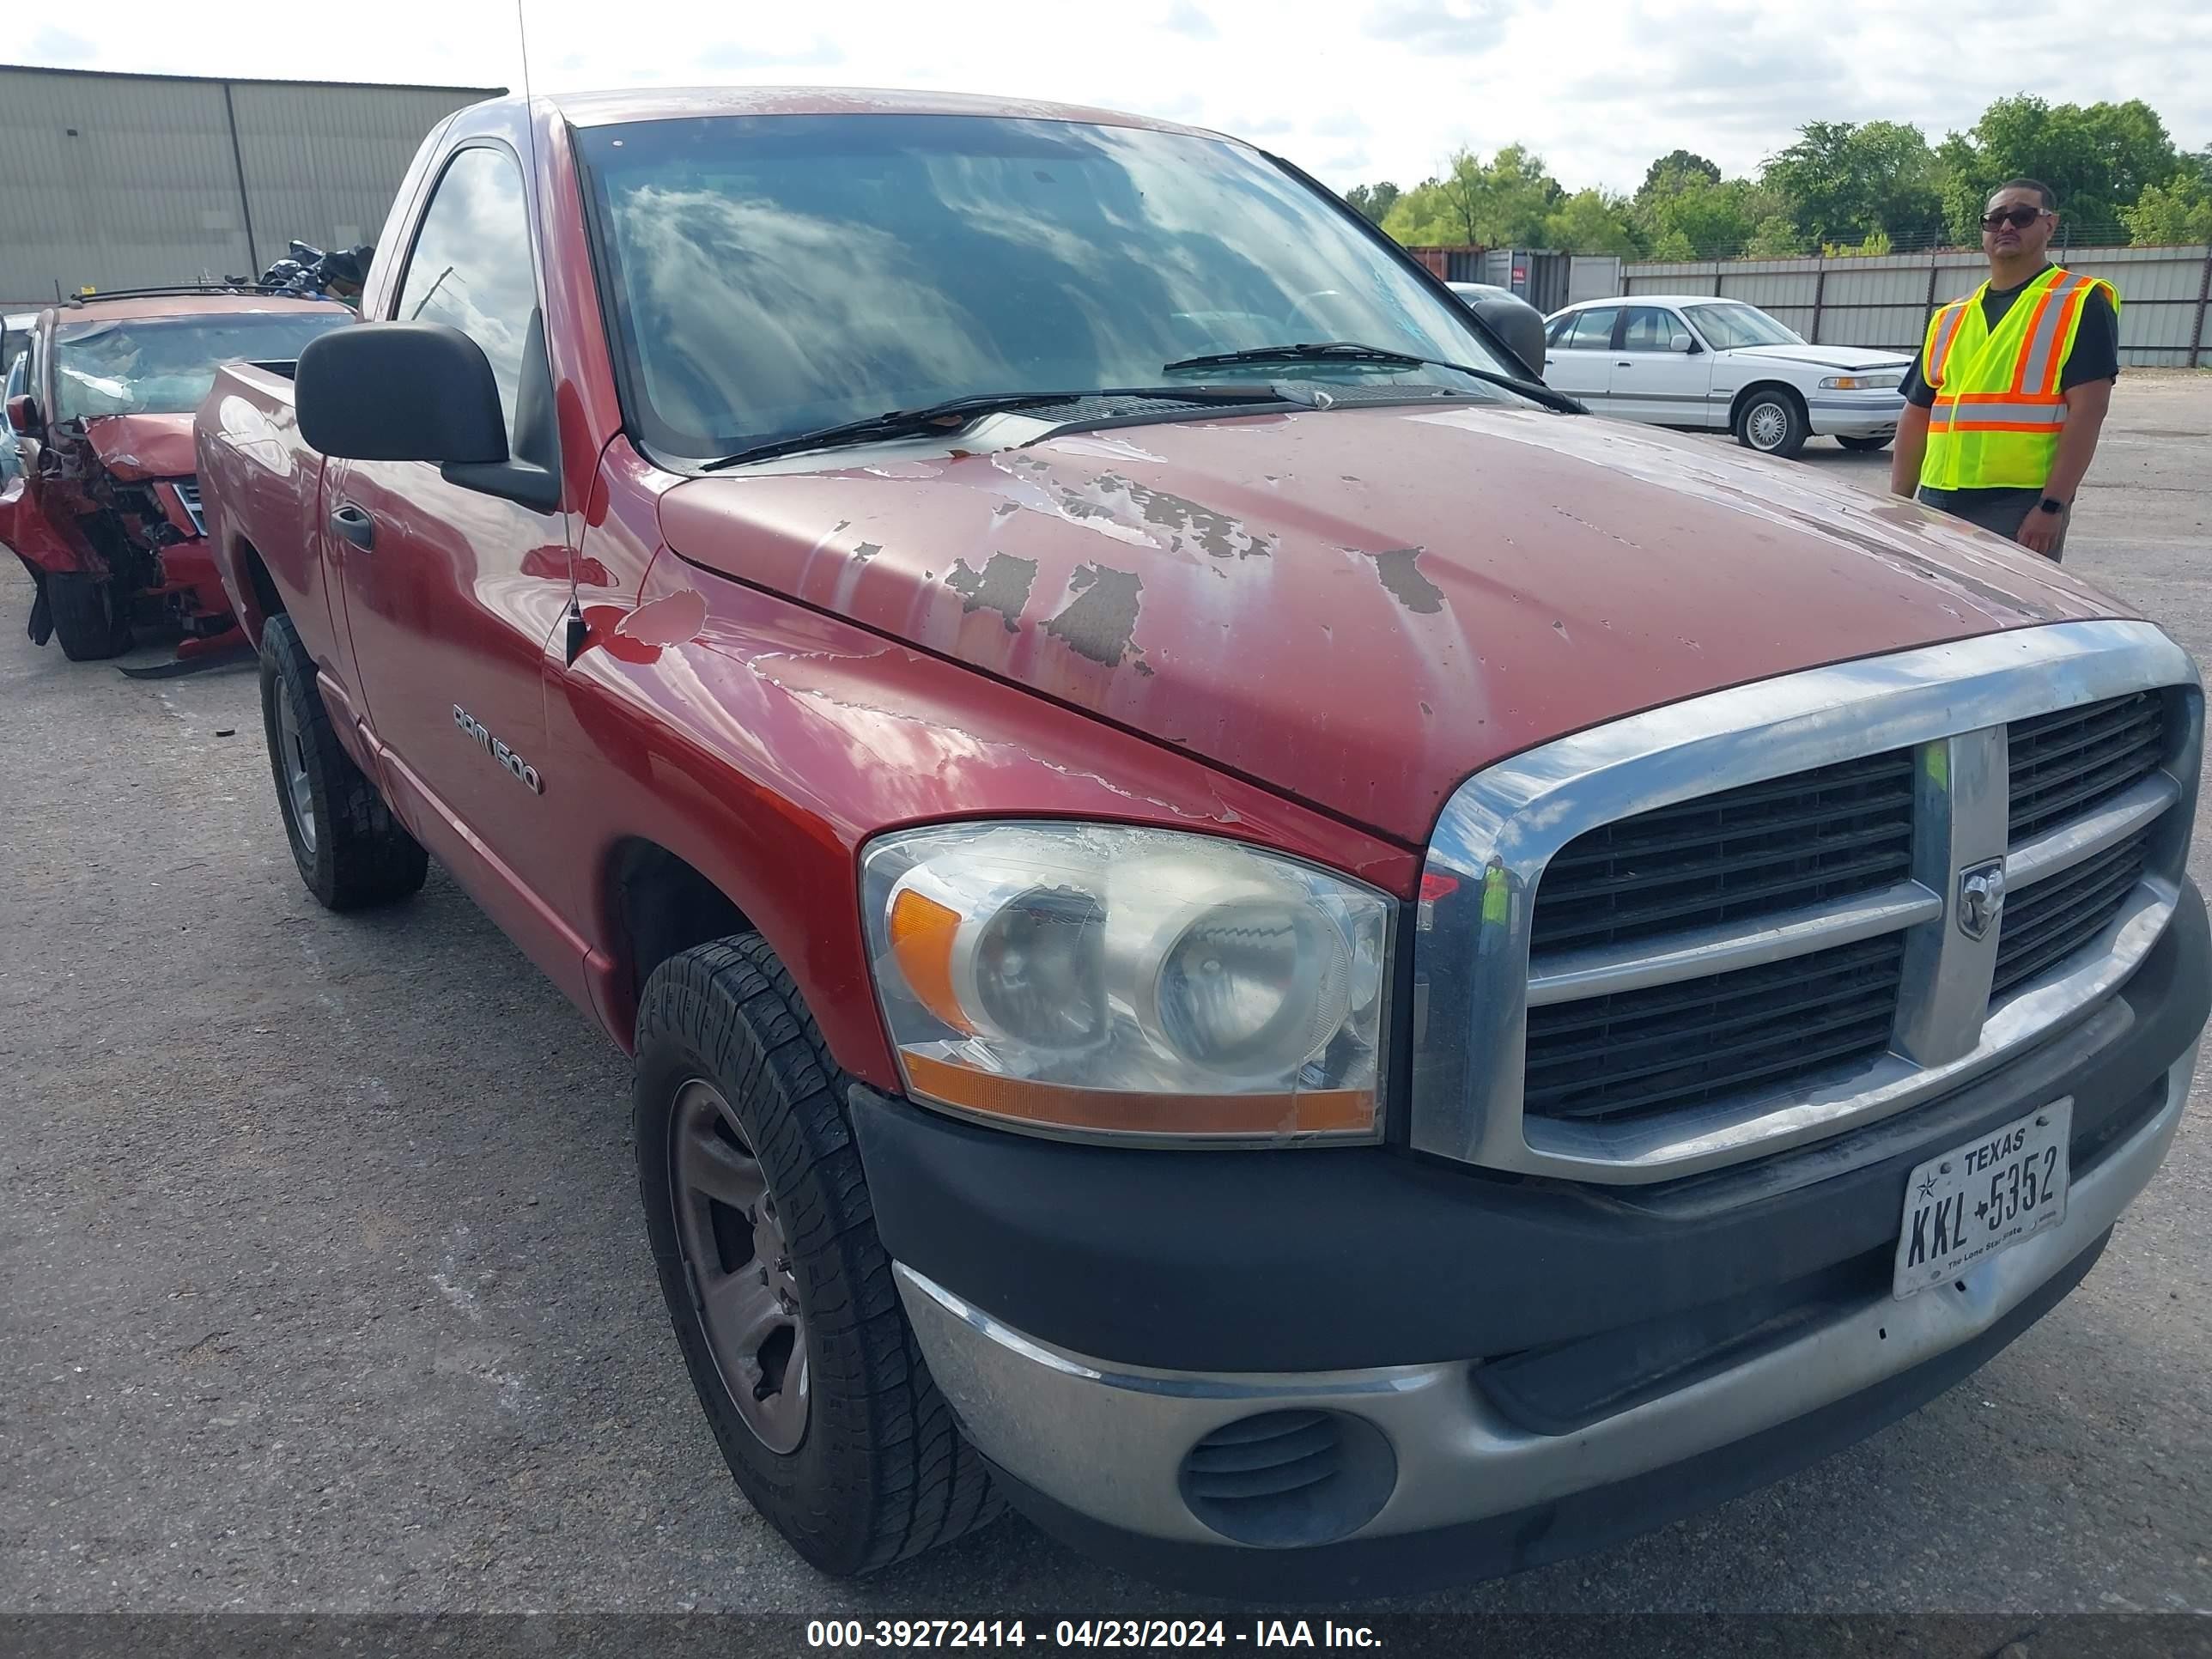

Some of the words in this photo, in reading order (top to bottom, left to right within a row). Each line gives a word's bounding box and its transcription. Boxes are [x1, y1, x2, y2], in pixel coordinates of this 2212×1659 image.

[492, 737, 540, 795] 1500
[1964, 1127, 2027, 1176] TEXAS
[1907, 1191, 1967, 1268] KKL
[1988, 1145, 2057, 1231] 5352
[1948, 1258, 1962, 1270] The
[1964, 1248, 1984, 1261] Lone
[1985, 1238, 2002, 1251] Star
